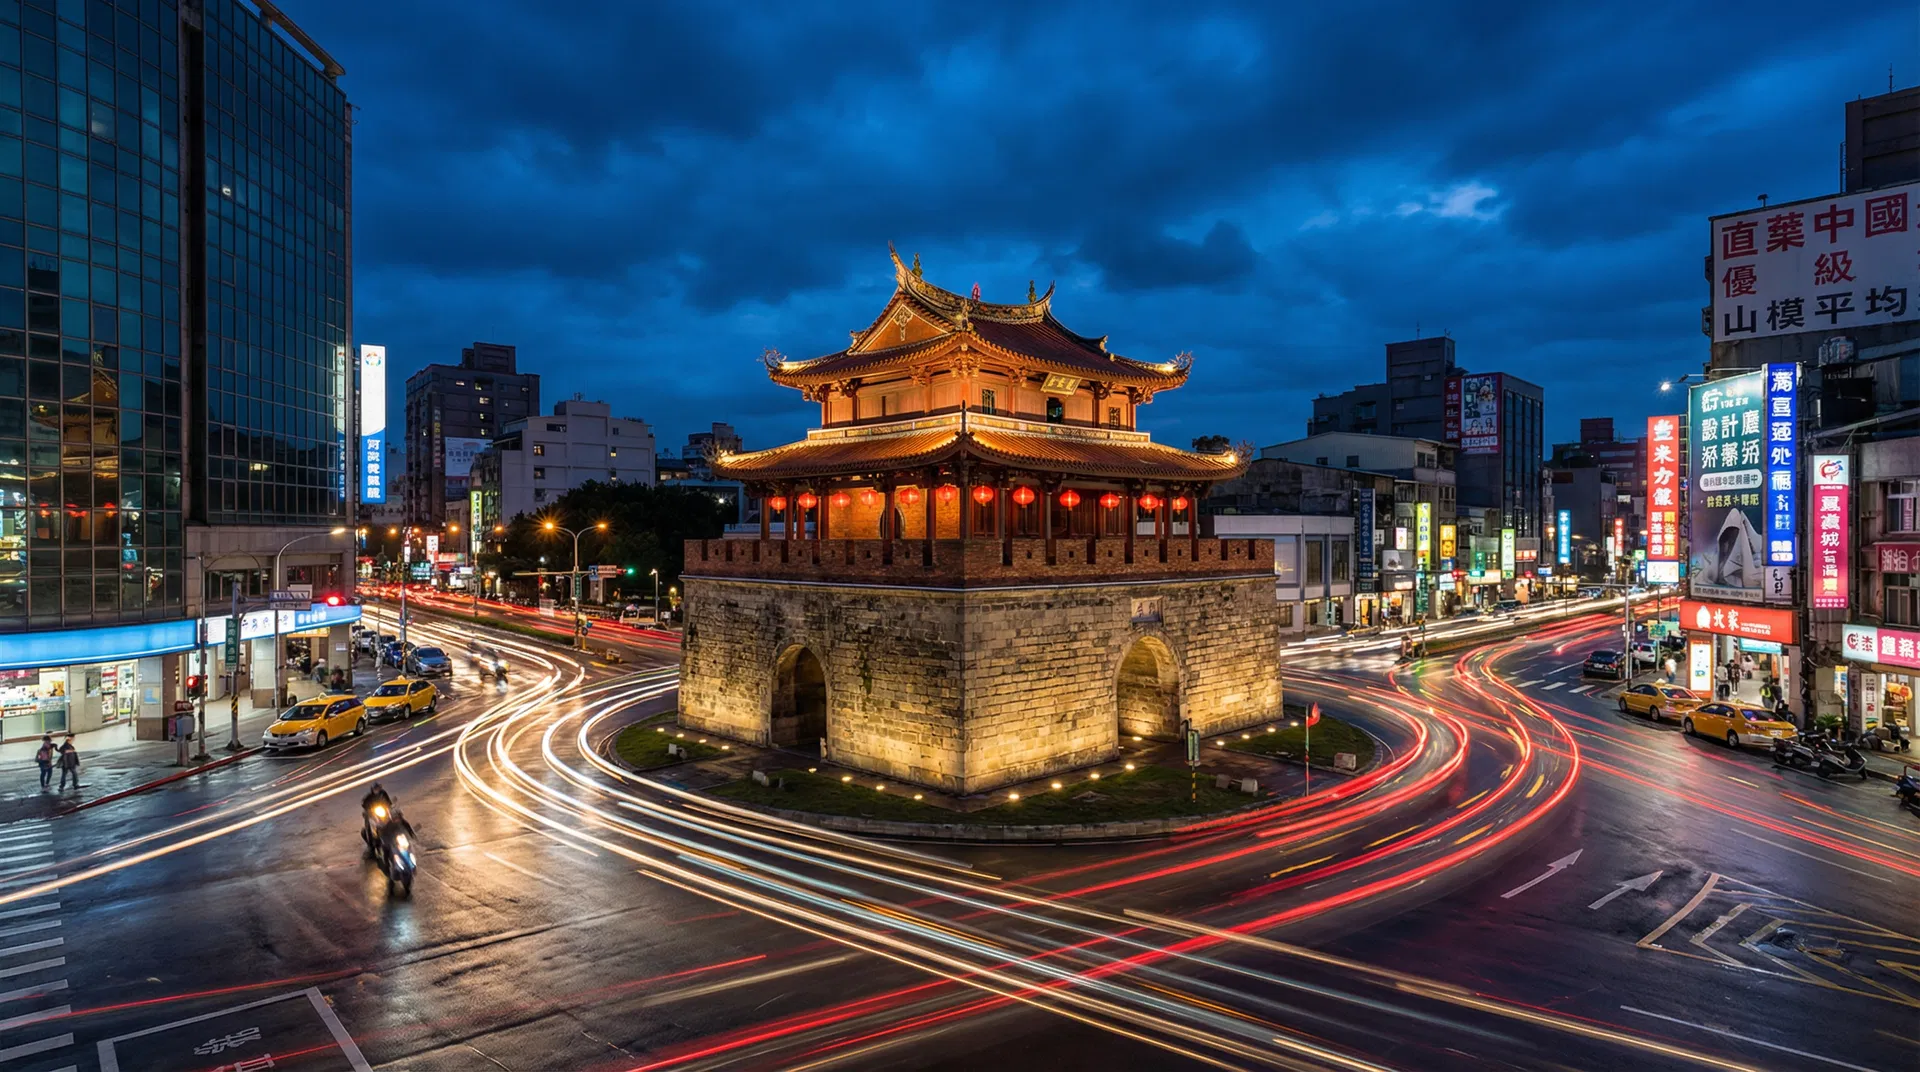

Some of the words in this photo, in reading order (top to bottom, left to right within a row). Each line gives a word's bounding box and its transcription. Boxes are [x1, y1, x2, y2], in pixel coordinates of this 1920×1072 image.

[1722, 192, 1920, 260] 直葉中國
[1724, 286, 1920, 336] 山模平均
